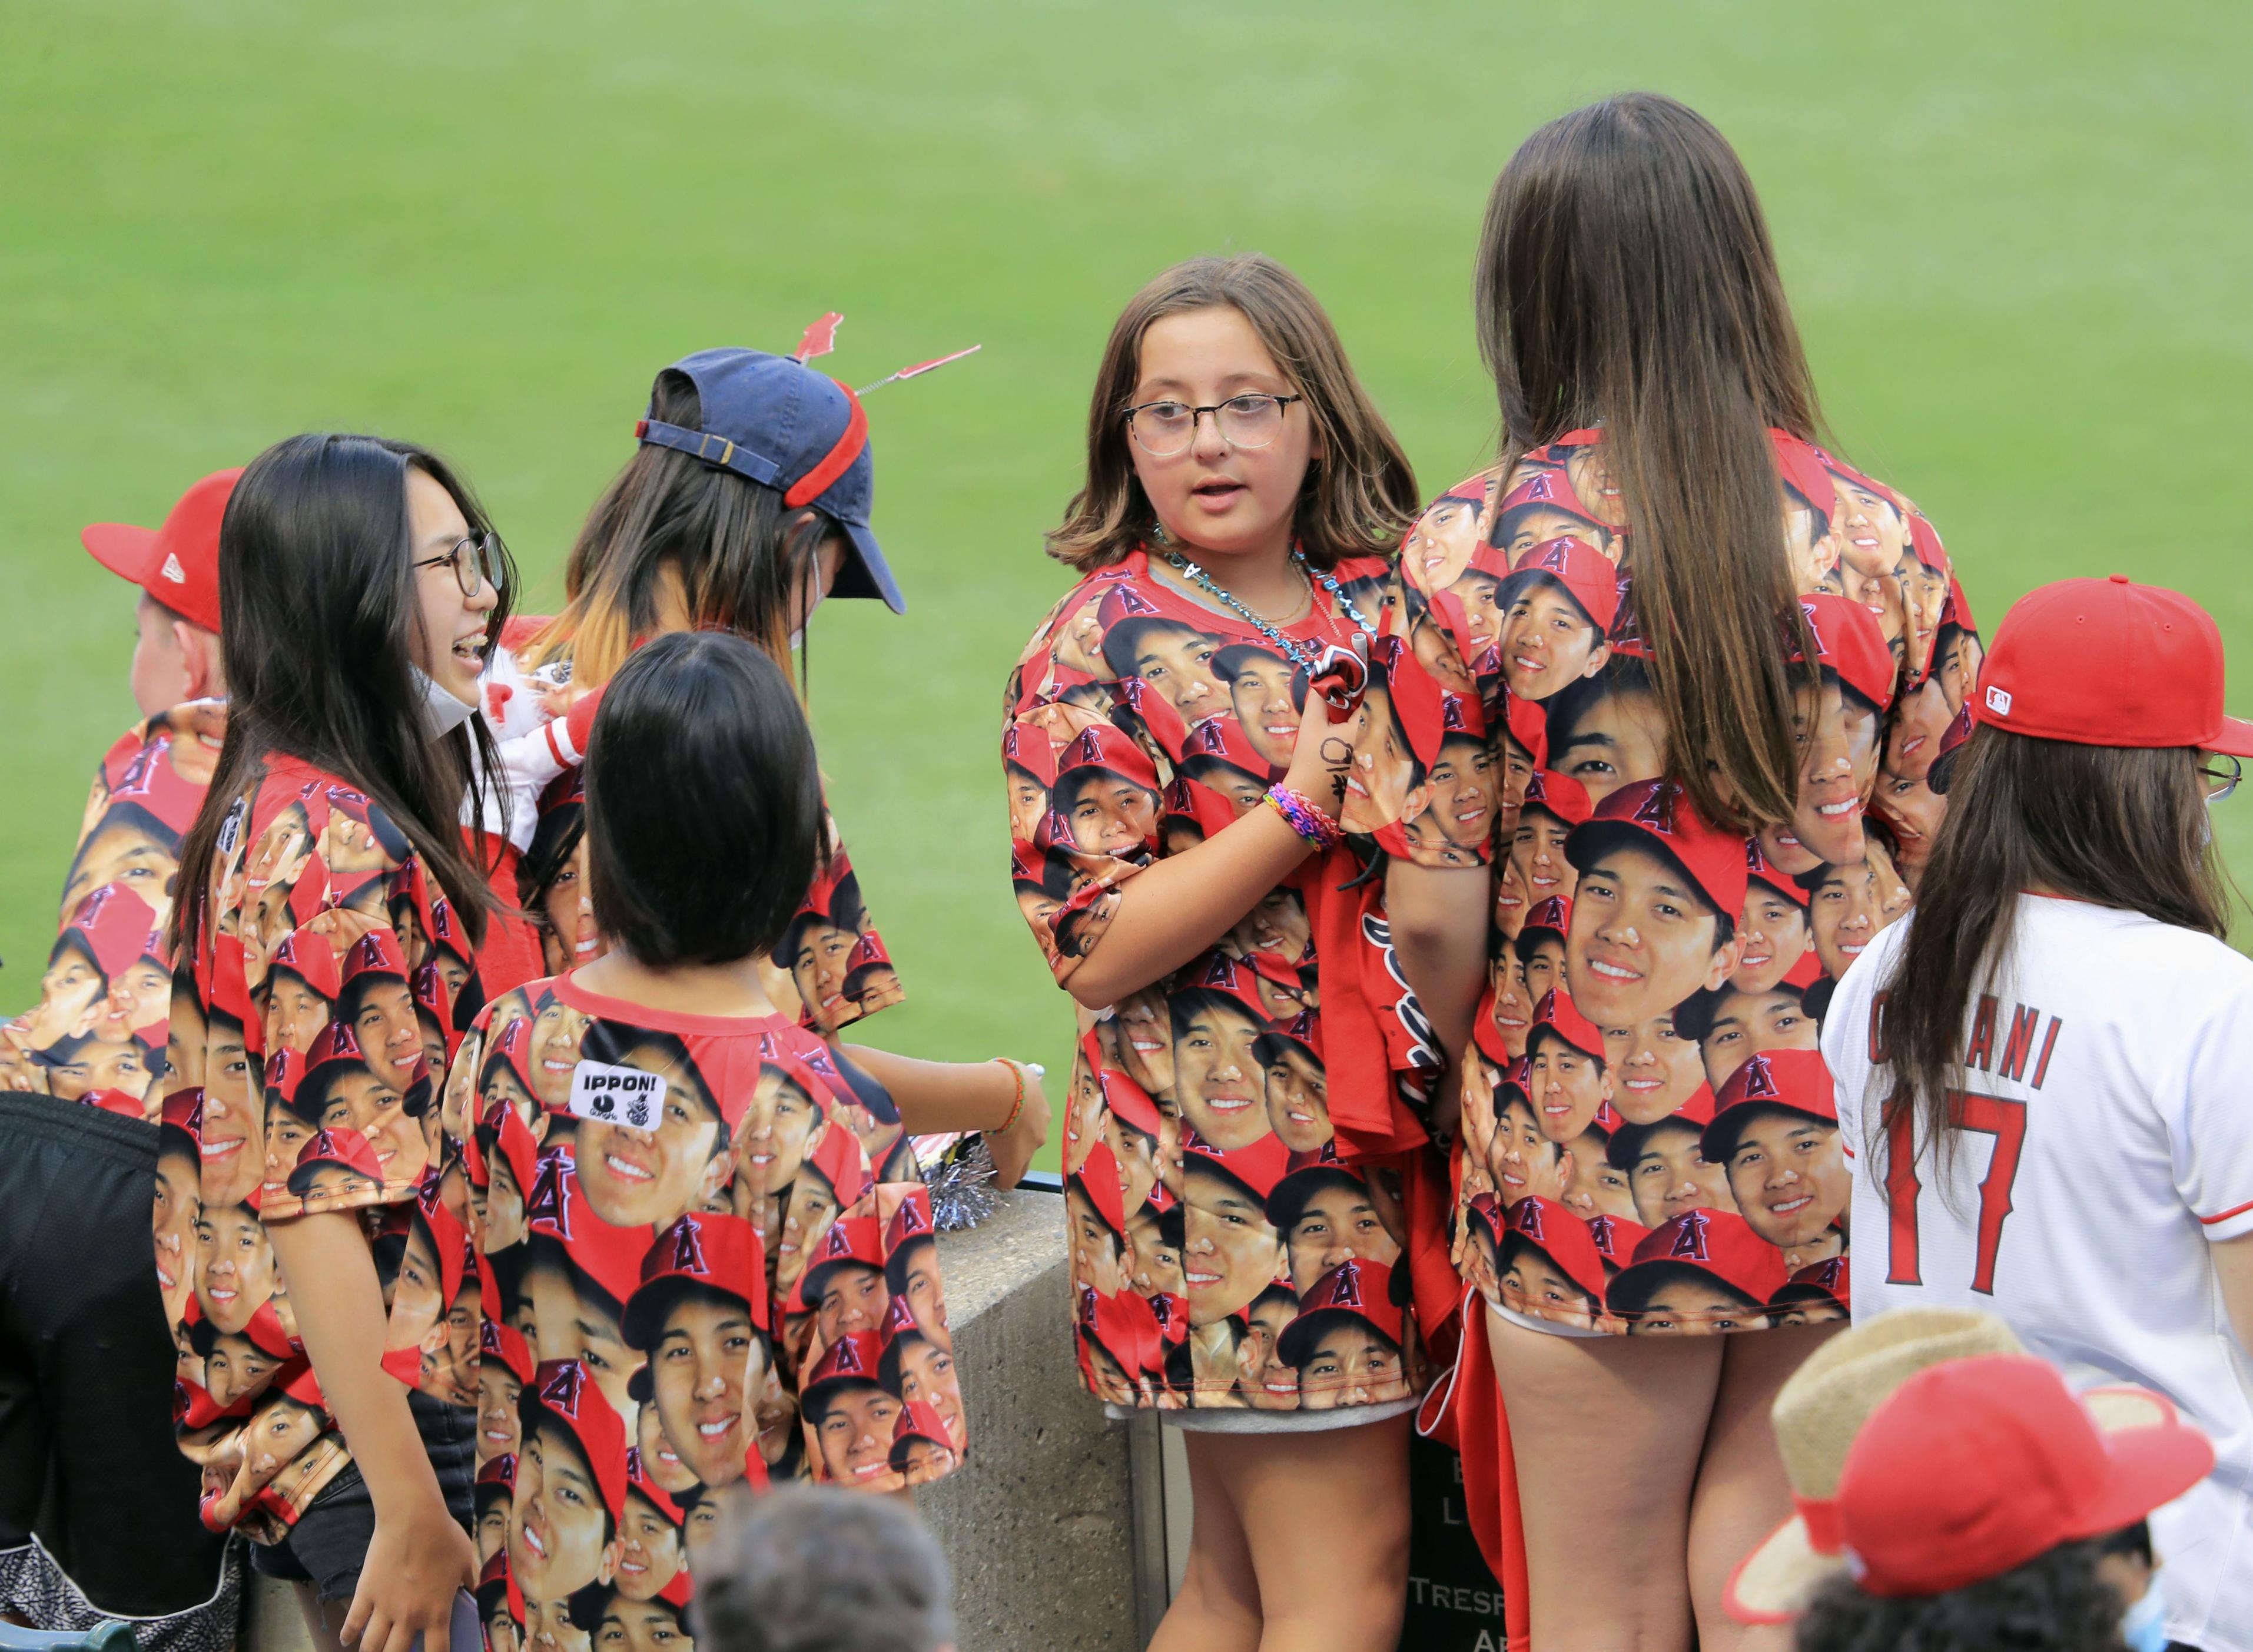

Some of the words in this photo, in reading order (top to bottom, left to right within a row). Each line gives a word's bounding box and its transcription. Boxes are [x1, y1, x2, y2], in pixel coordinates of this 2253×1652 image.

[1527, 473, 1554, 500] A
[1539, 537, 1575, 575] A
[1115, 583, 1162, 615] A
[1485, 645, 1502, 672] A
[1125, 678, 1147, 711] A
[1443, 693, 1466, 729] A
[1007, 725, 1020, 757] A
[1080, 727, 1105, 763] A
[1202, 719, 1229, 755] A
[1173, 775, 1193, 812] A
[1526, 770, 1548, 800] A
[1050, 810, 1075, 842] A
[1632, 782, 1683, 834] A
[1544, 895, 1566, 930] A
[276, 932, 297, 963] A
[361, 933, 390, 968] A
[861, 935, 882, 961] A
[418, 961, 439, 1005] A
[1204, 951, 1240, 990] A
[332, 1022, 360, 1056] A
[1289, 1010, 1312, 1043] A
[1868, 990, 2062, 1090] OANI
[584, 1075, 657, 1091] IPPON!
[1744, 1054, 1778, 1097] A
[316, 1129, 338, 1156] A
[530, 1147, 576, 1240] A
[1881, 1087, 2028, 1296] 17
[902, 1197, 927, 1235] A
[1519, 1196, 1545, 1240] A
[672, 1213, 711, 1274] A
[825, 1222, 852, 1256] A
[1591, 1215, 1615, 1255] A
[1669, 1210, 1711, 1260] A
[1330, 1260, 1363, 1306] A
[1815, 1256, 1844, 1288] A
[1154, 1293, 1173, 1331] A
[481, 1320, 503, 1354] A
[835, 1335, 863, 1372] A
[540, 1361, 586, 1420] A
[902, 1405, 919, 1431] A
